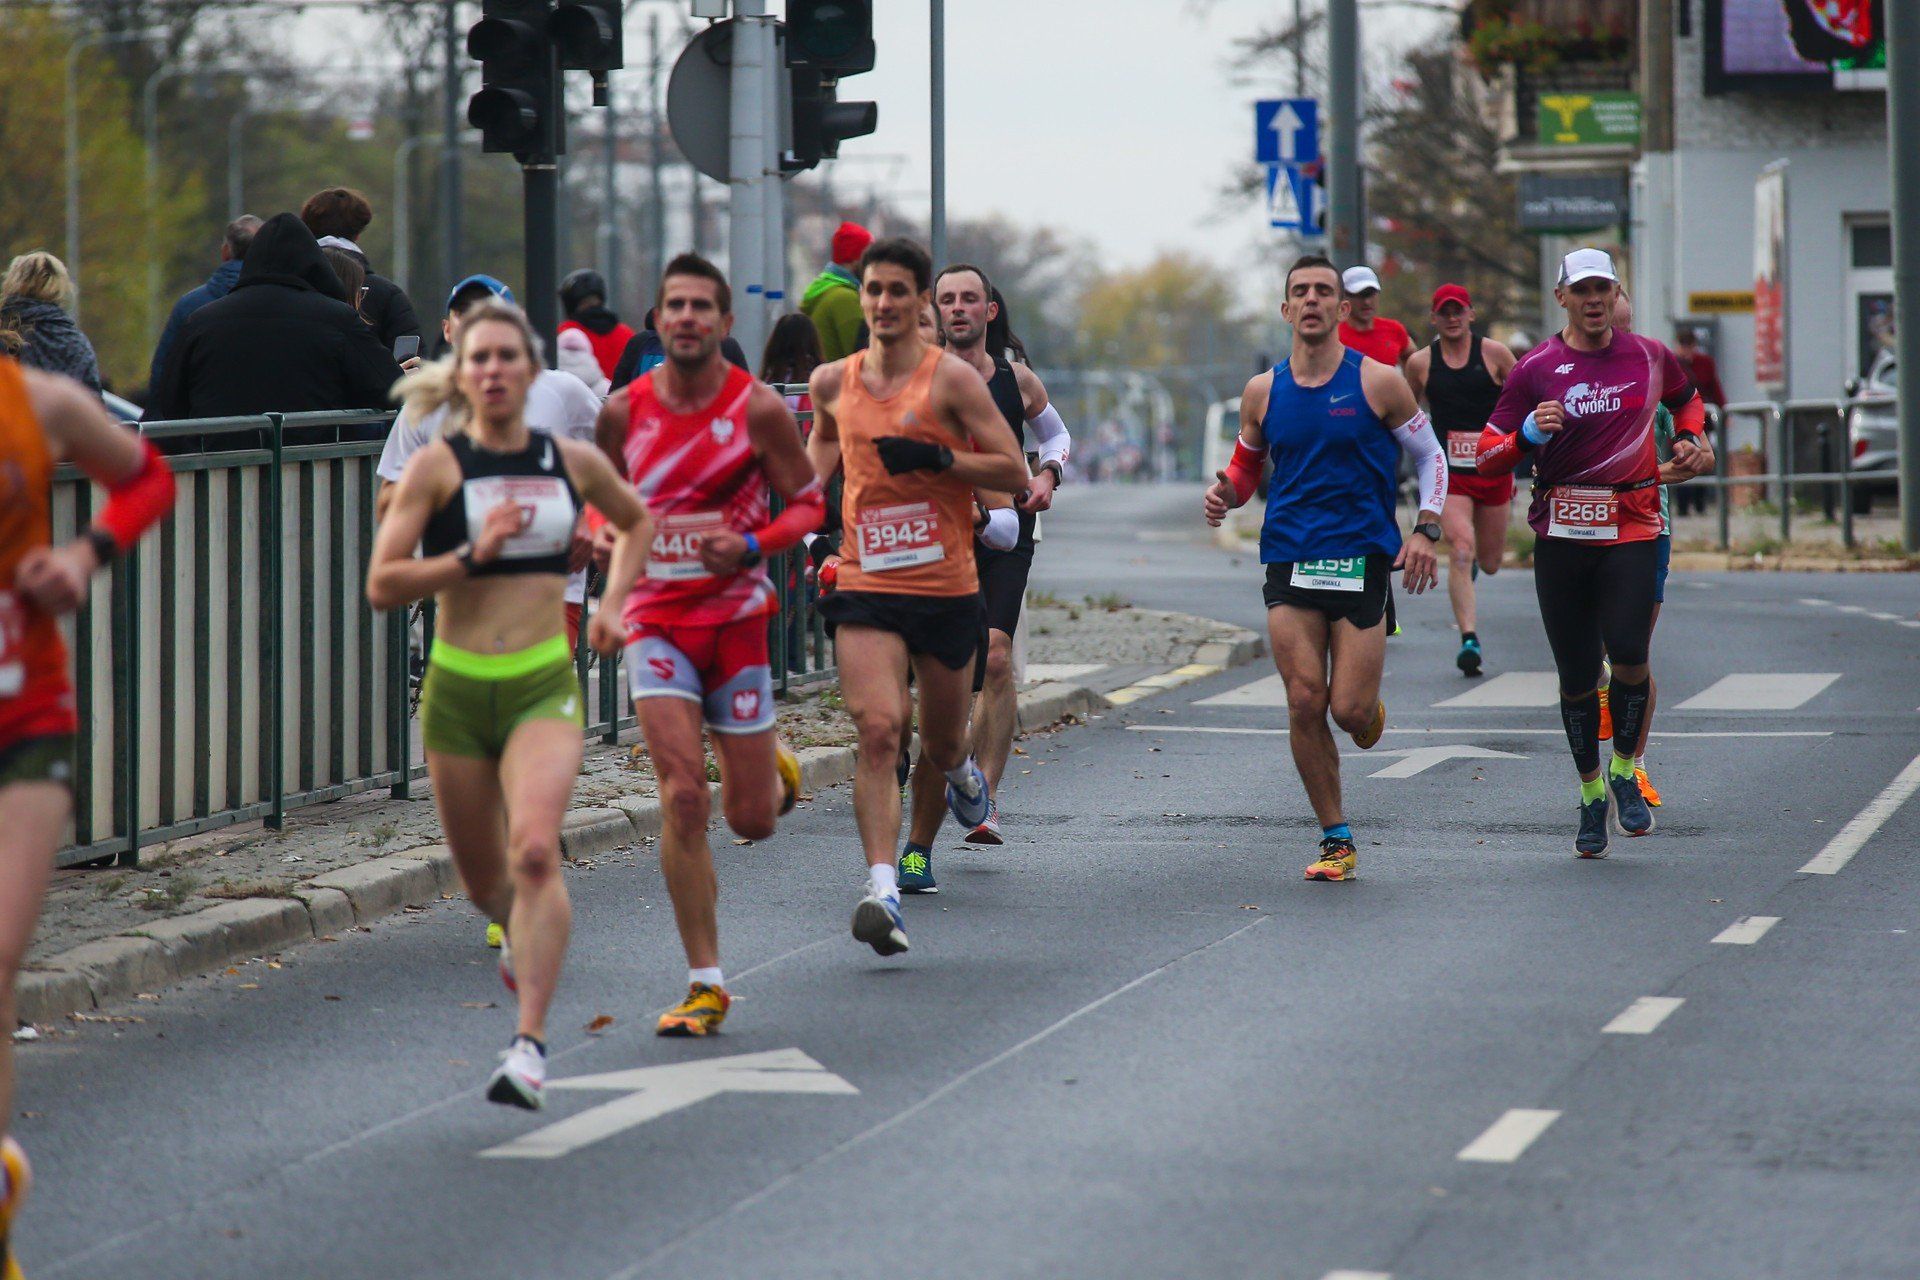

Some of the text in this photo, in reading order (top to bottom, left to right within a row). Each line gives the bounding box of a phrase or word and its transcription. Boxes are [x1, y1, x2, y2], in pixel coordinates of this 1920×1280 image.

[1555, 363, 1575, 375] 4F
[1578, 398, 1621, 415] WORLD
[1558, 502, 1609, 521] 2268
[867, 520, 930, 549] 3942
